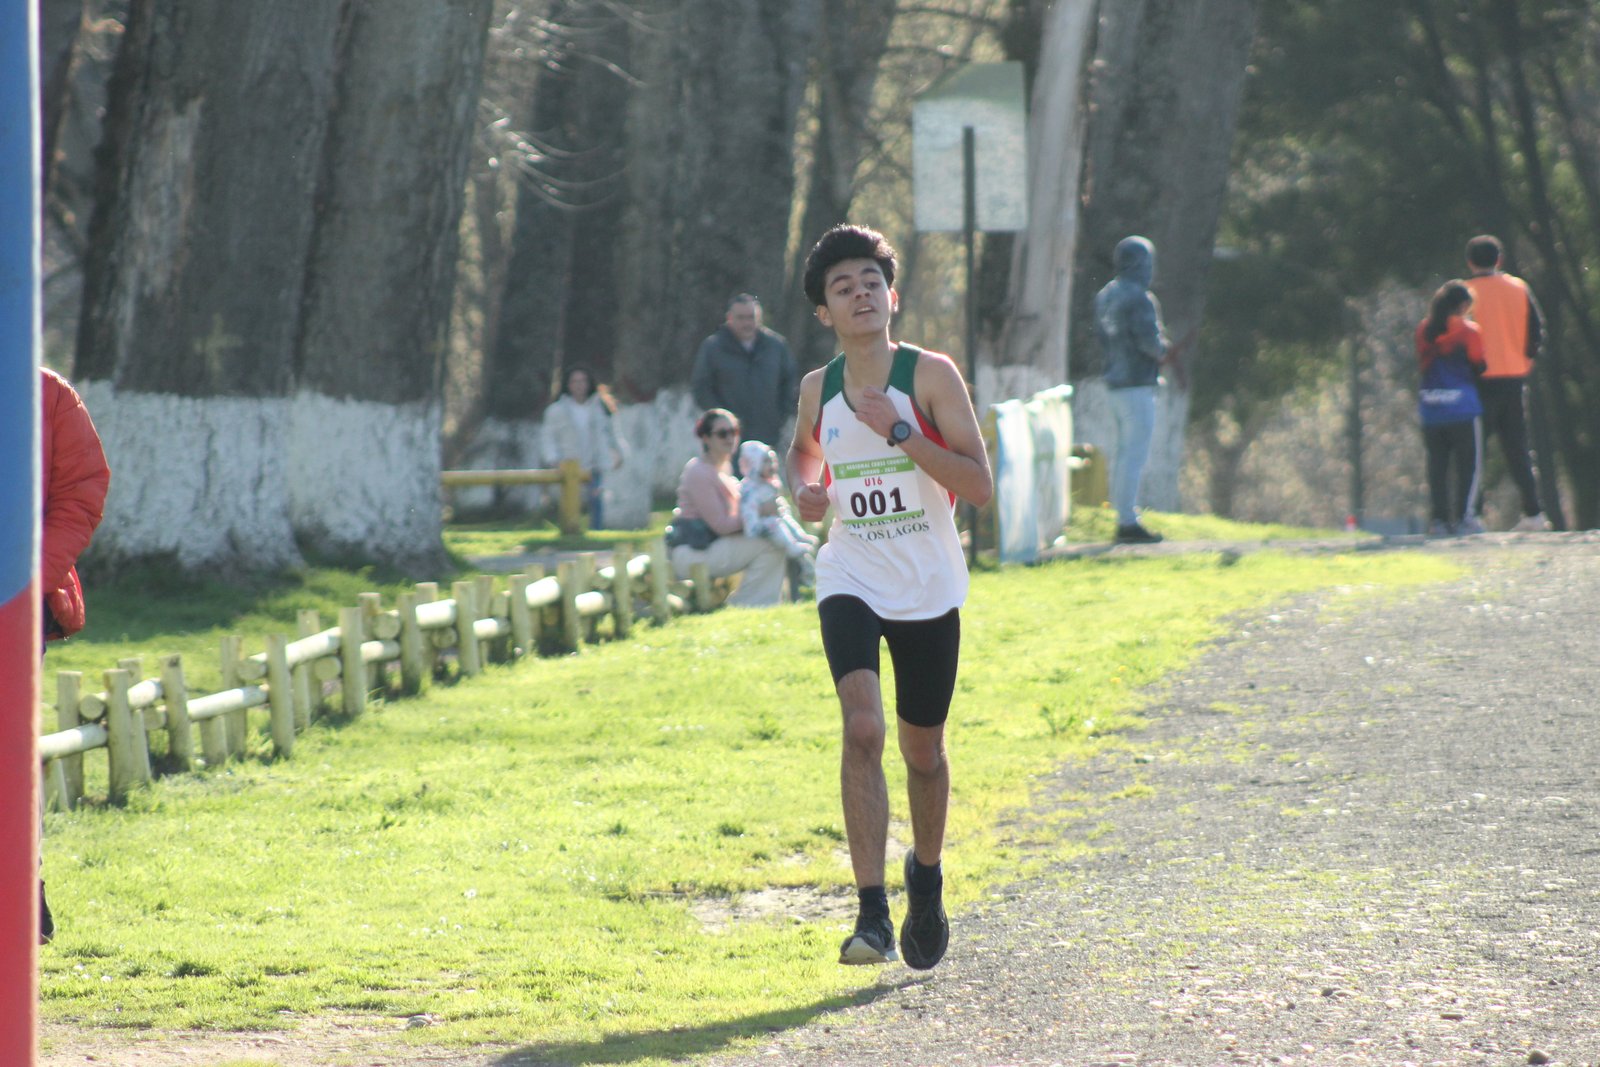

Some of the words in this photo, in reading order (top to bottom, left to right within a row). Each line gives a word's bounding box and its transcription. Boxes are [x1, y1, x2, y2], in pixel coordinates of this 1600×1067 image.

[864, 477, 883, 487] U16
[850, 487, 907, 517] 001
[886, 520, 930, 539] LAGOS
